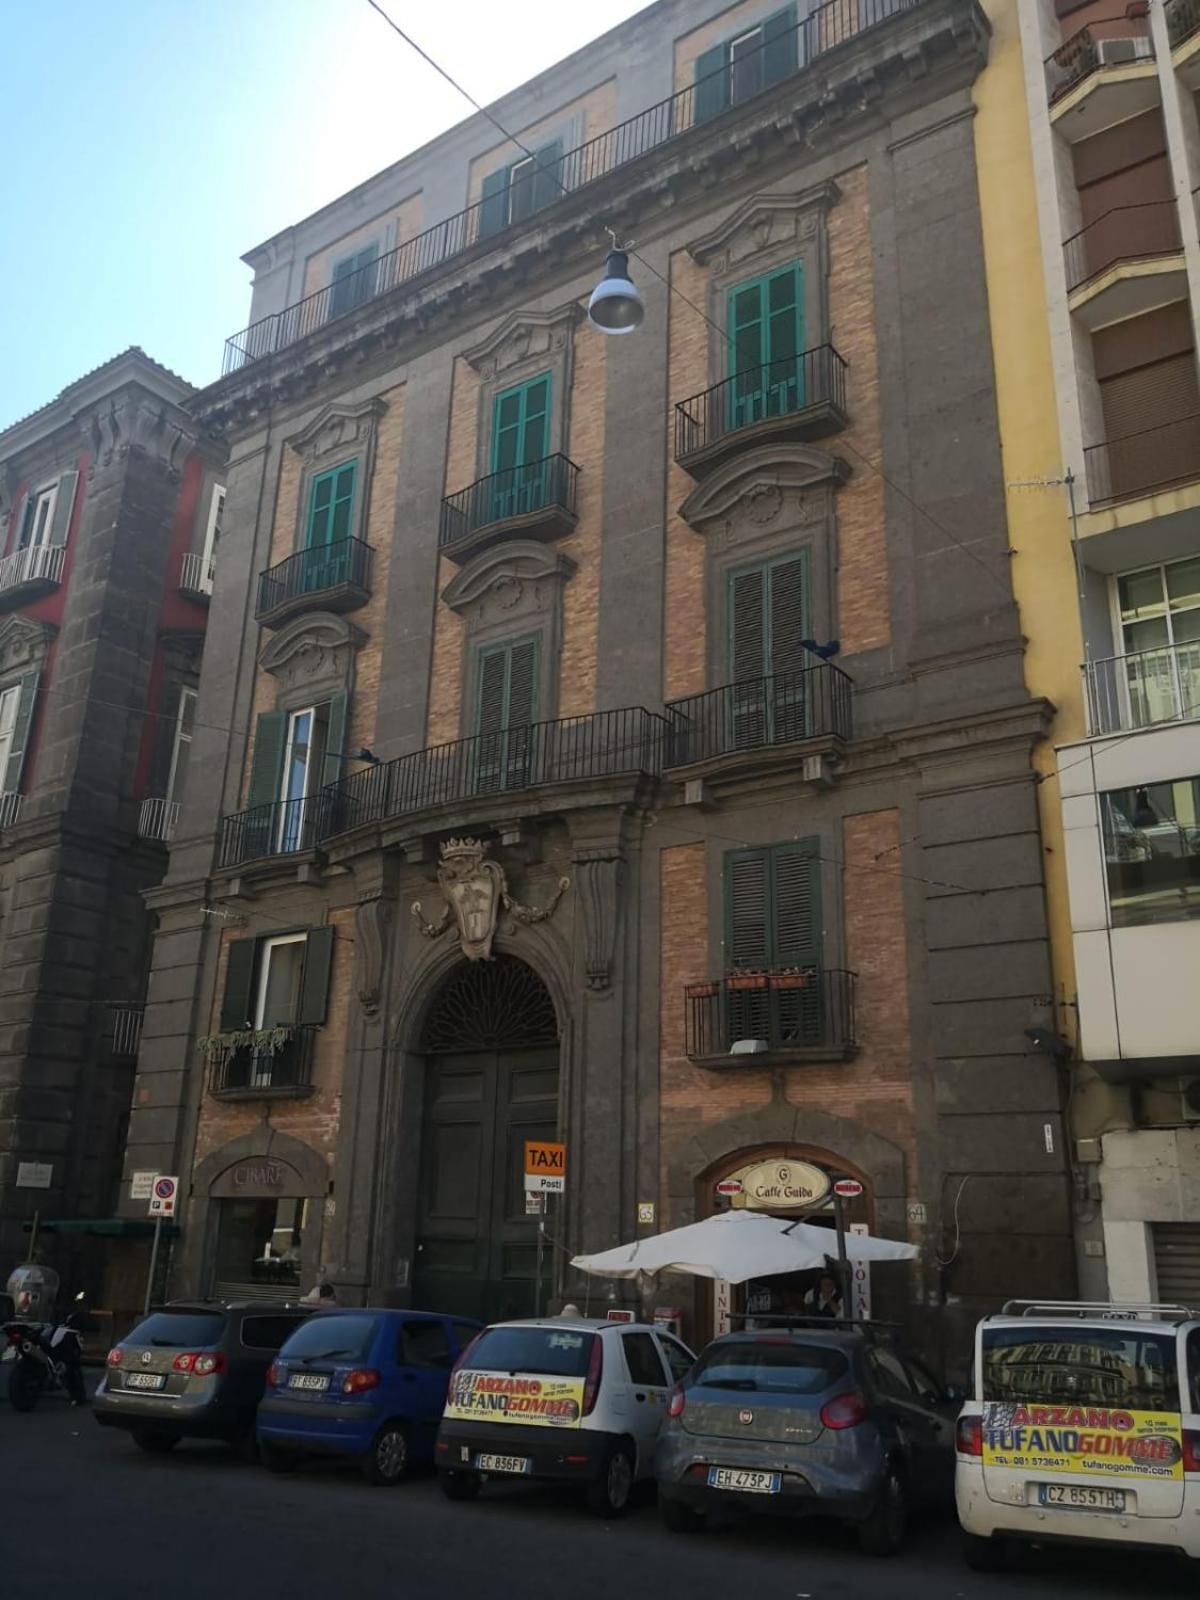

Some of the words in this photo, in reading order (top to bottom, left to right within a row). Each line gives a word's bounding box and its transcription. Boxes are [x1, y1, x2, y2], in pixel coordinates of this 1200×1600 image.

[529, 1150, 563, 1168] TAXI
[541, 1178, 562, 1189] Posti
[1082, 1459, 1173, 1476] tufanogomme.com
[718, 1470, 732, 1484] EH
[736, 1472, 772, 1488] 473PJ
[1049, 1486, 1065, 1502] CZ
[1071, 1488, 1115, 1506] 855TH
